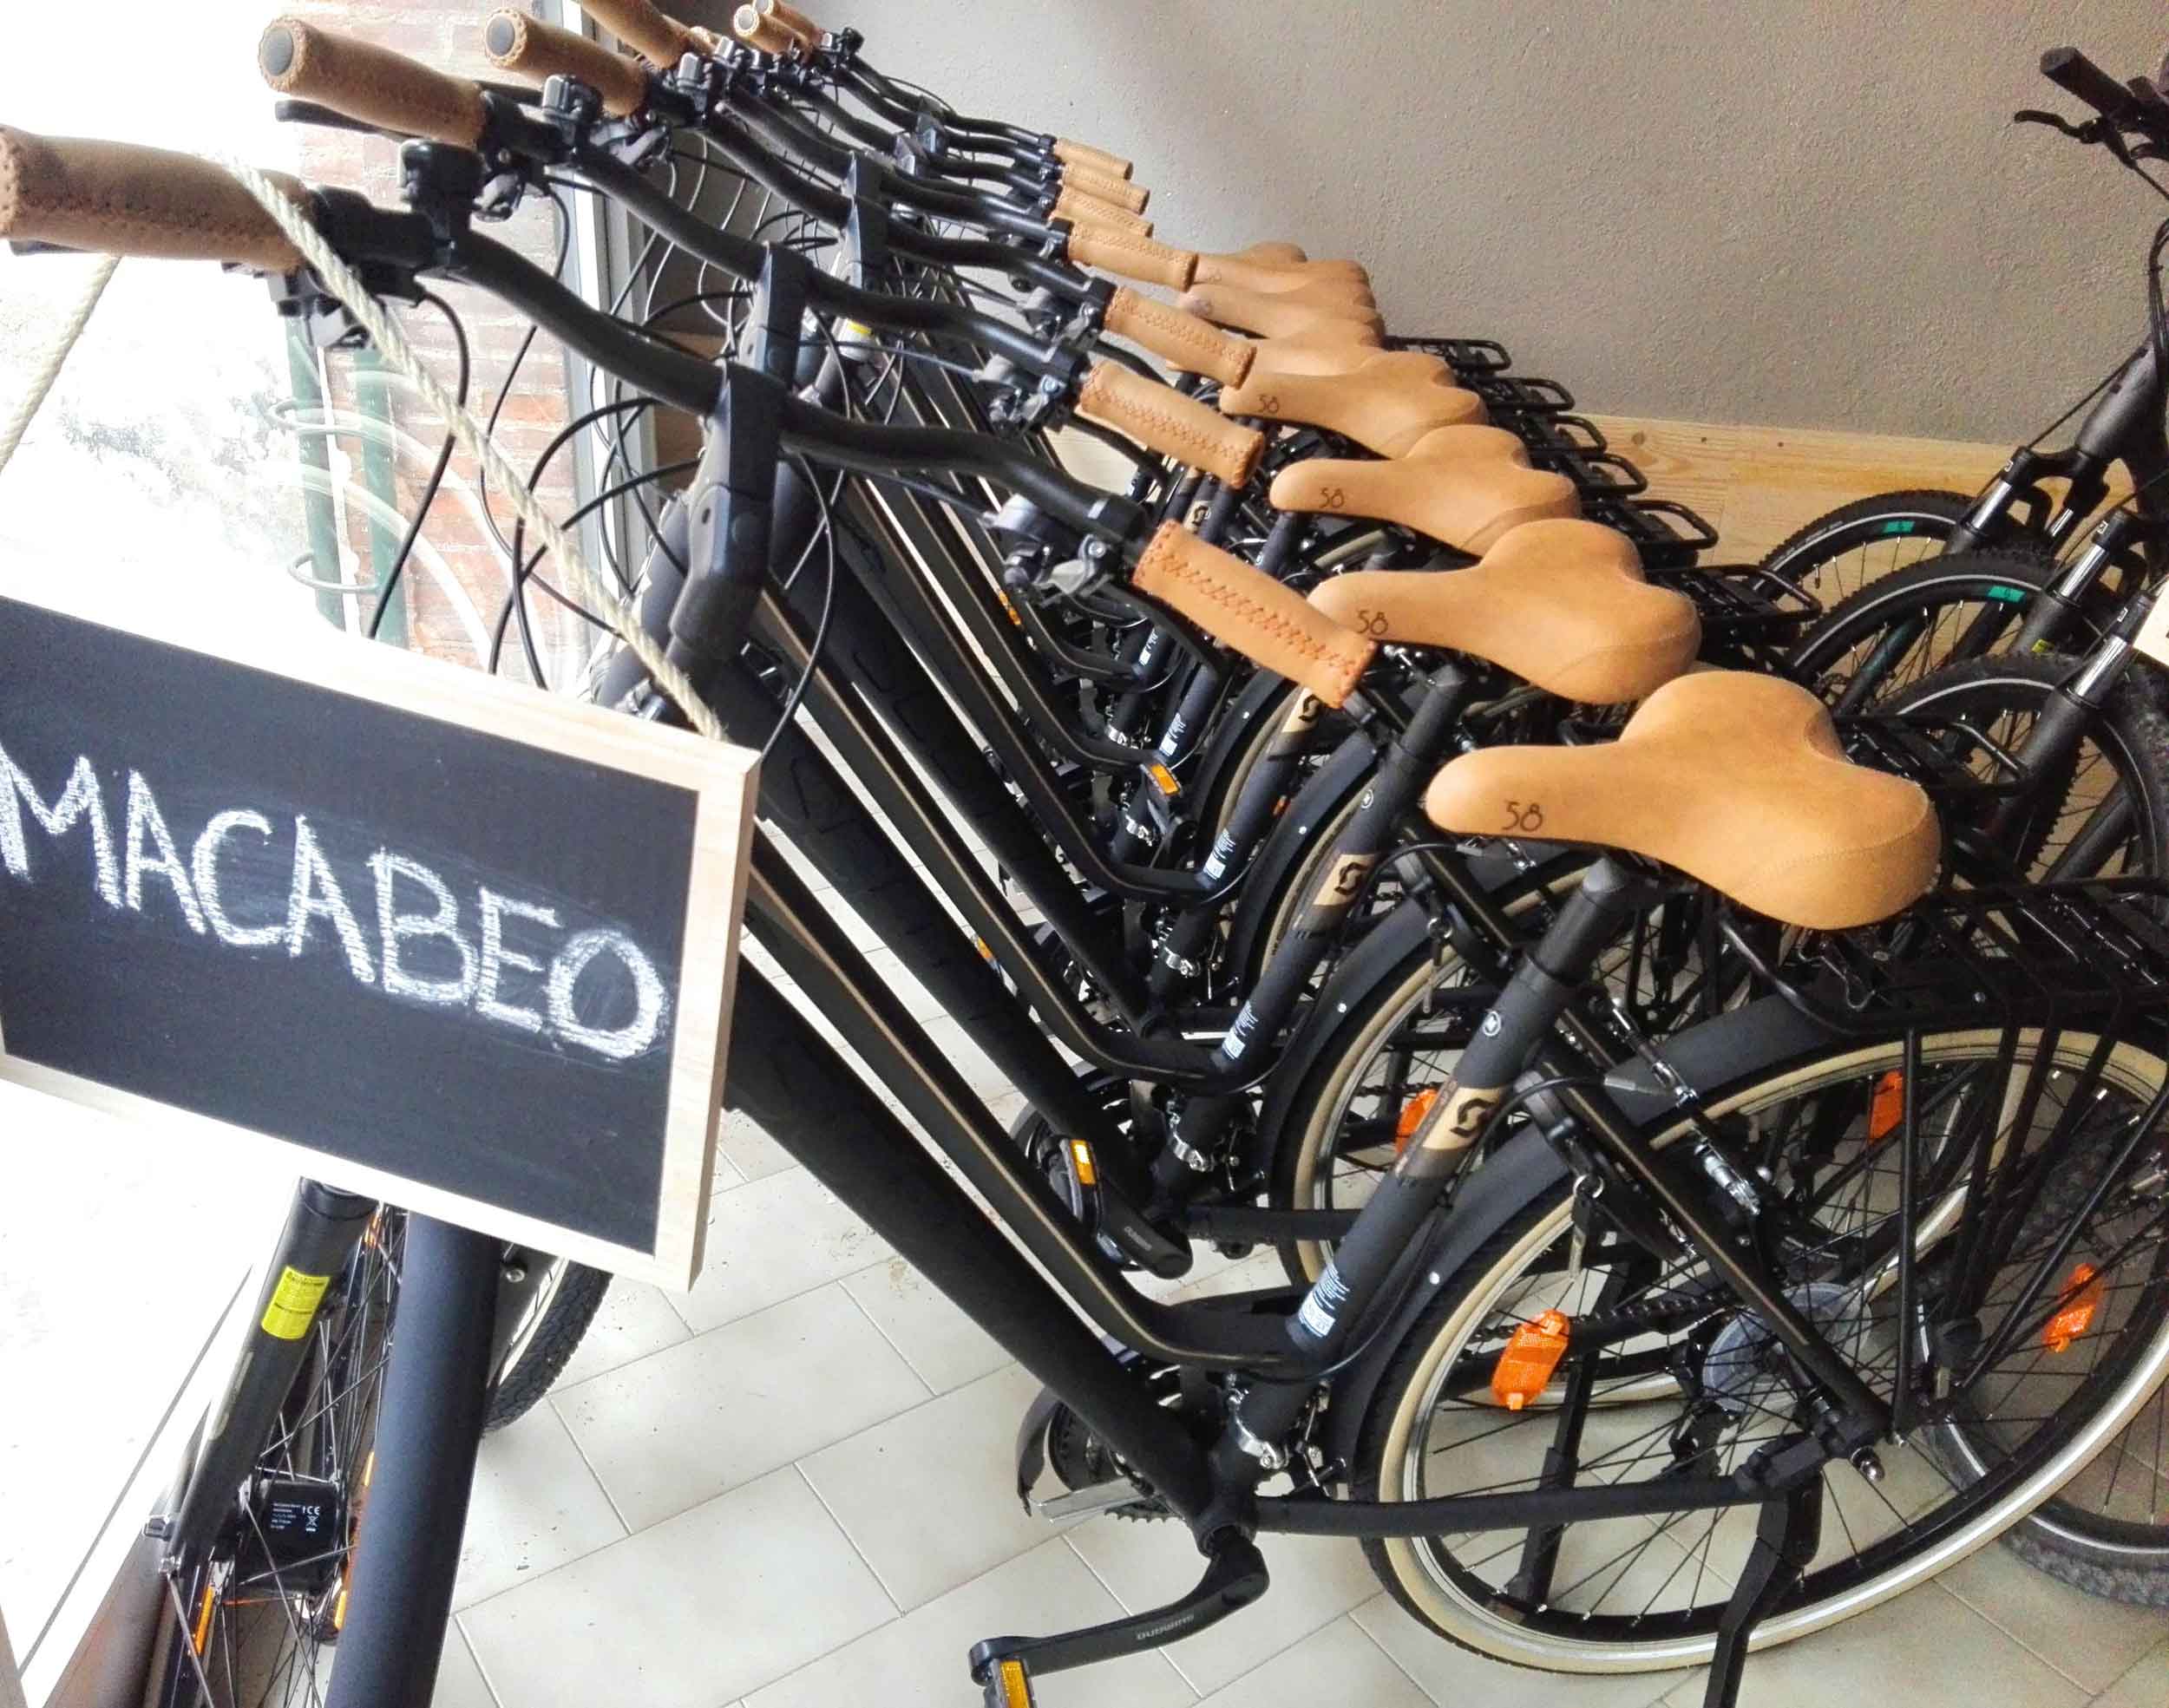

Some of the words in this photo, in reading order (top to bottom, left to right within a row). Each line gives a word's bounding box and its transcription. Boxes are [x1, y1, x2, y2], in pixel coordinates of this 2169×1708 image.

[1356, 609, 1388, 636] 58
[1502, 800, 1543, 833] 58
[0, 742, 668, 1060] MACABEO
